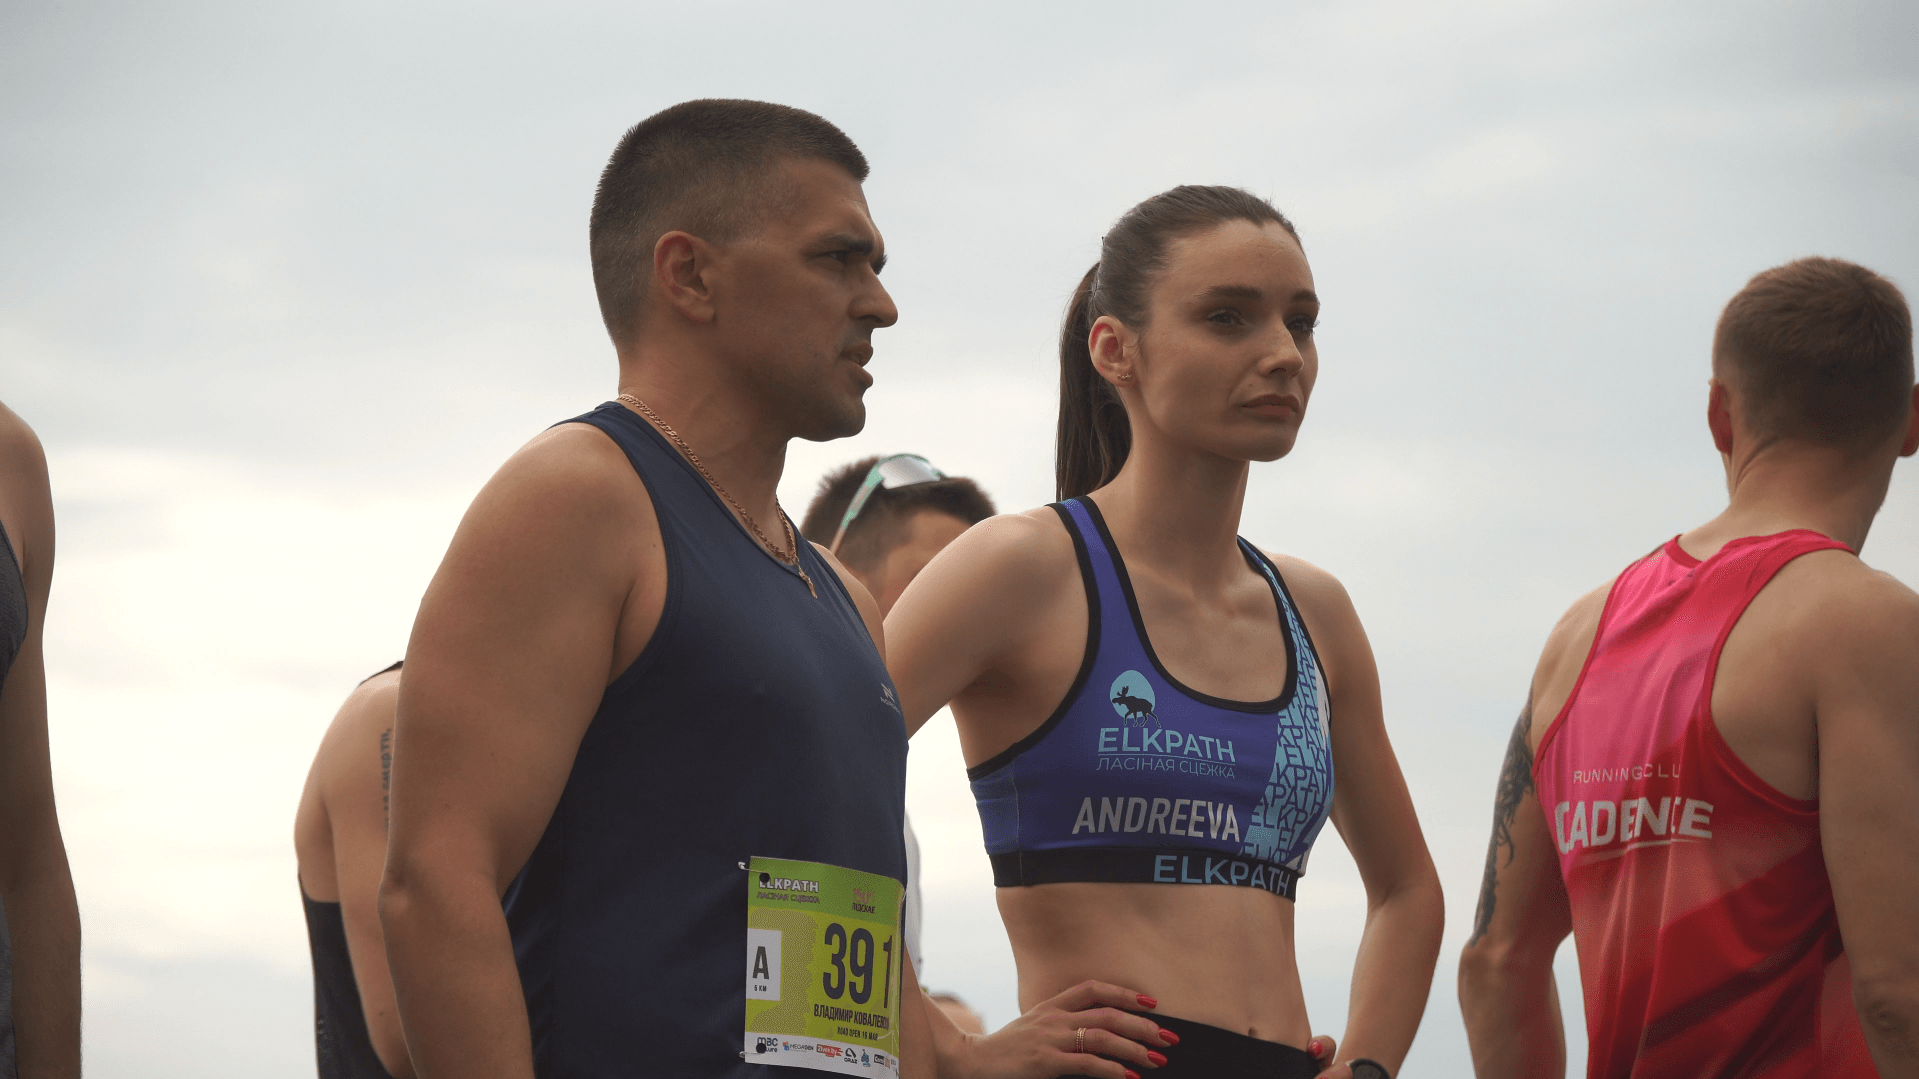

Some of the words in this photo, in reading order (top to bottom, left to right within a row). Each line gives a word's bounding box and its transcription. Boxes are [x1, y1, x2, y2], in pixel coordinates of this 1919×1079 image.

[1098, 727, 1236, 762] ELKPATH
[1096, 757, 1175, 772] ЛАСІНАЯ
[1179, 760, 1235, 779] СЦЕЖКА
[1071, 797, 1240, 843] ANDREEVA
[1153, 854, 1291, 896] ELKPATH
[752, 946, 770, 980] A
[823, 922, 893, 1009] 391
[813, 1003, 853, 1023] ВЛАДИМИР
